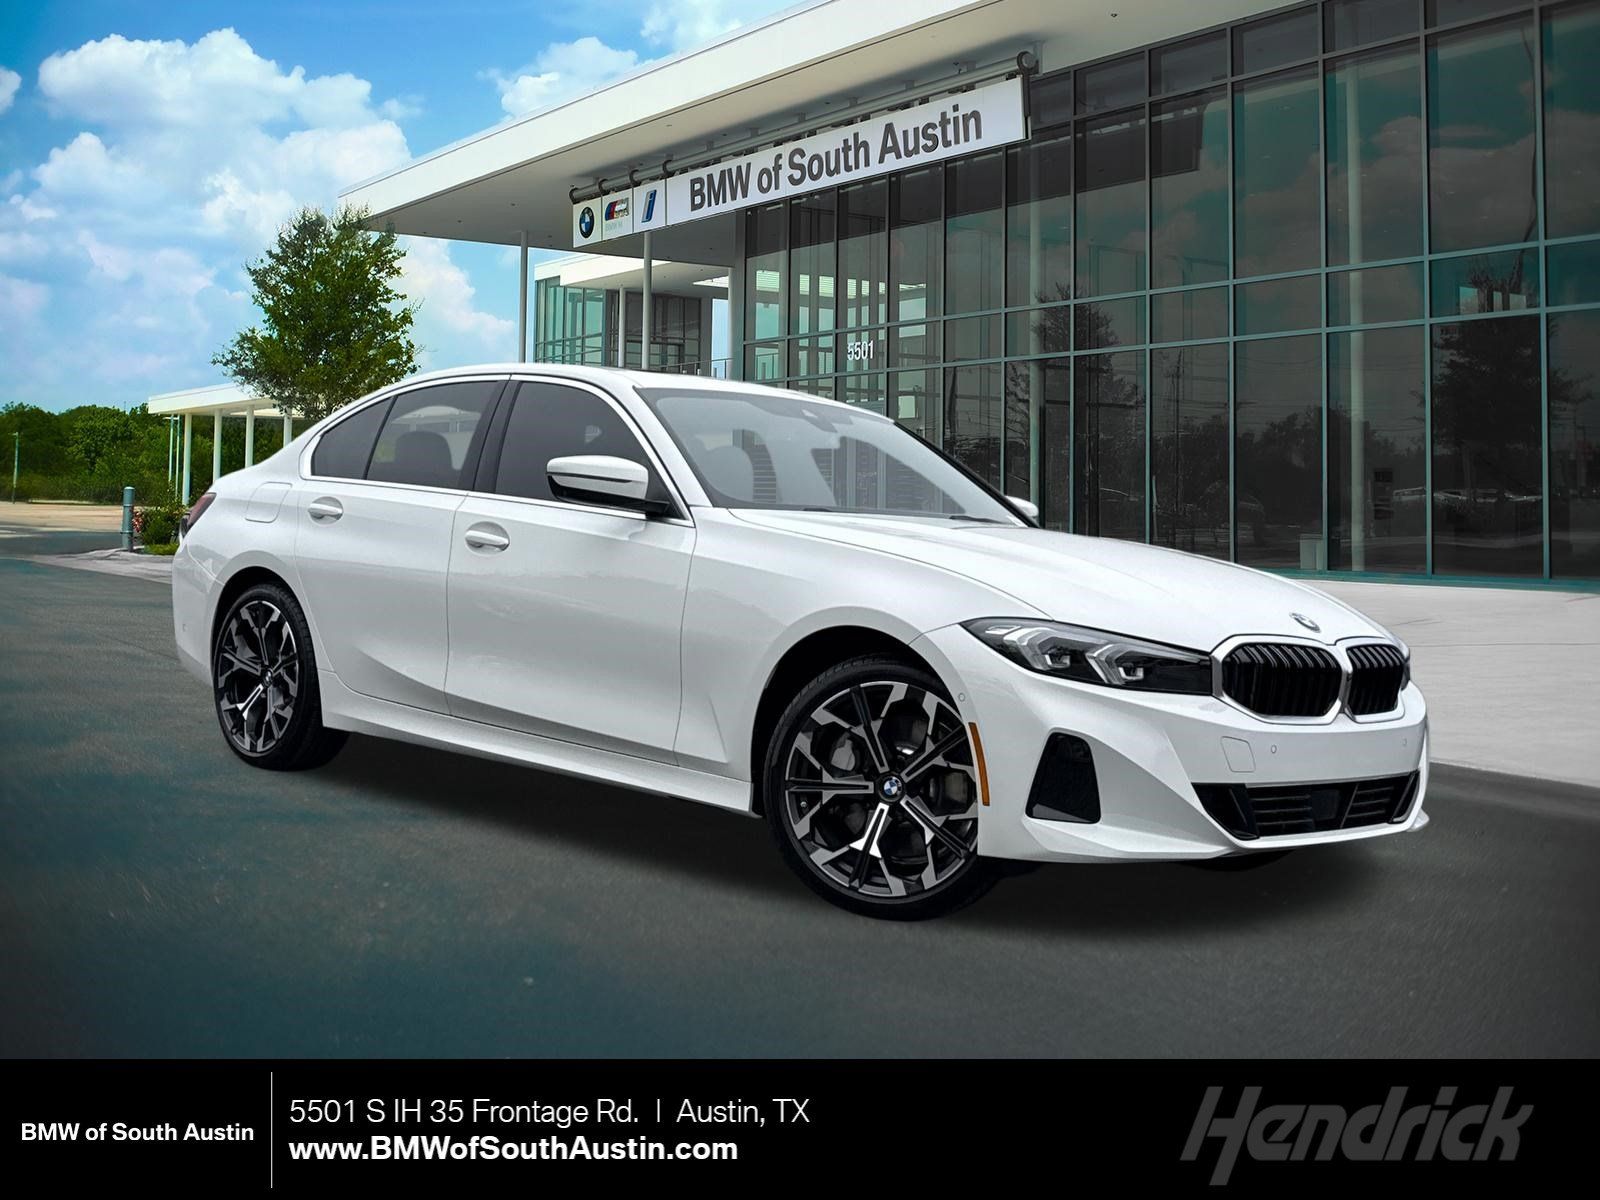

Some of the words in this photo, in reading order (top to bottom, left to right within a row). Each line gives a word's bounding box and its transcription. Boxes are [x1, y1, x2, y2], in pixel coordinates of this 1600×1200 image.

[690, 162, 752, 212] BMW
[757, 153, 783, 194] of
[788, 132, 871, 187] South
[878, 104, 983, 164] Austin
[847, 340, 874, 360] 5501
